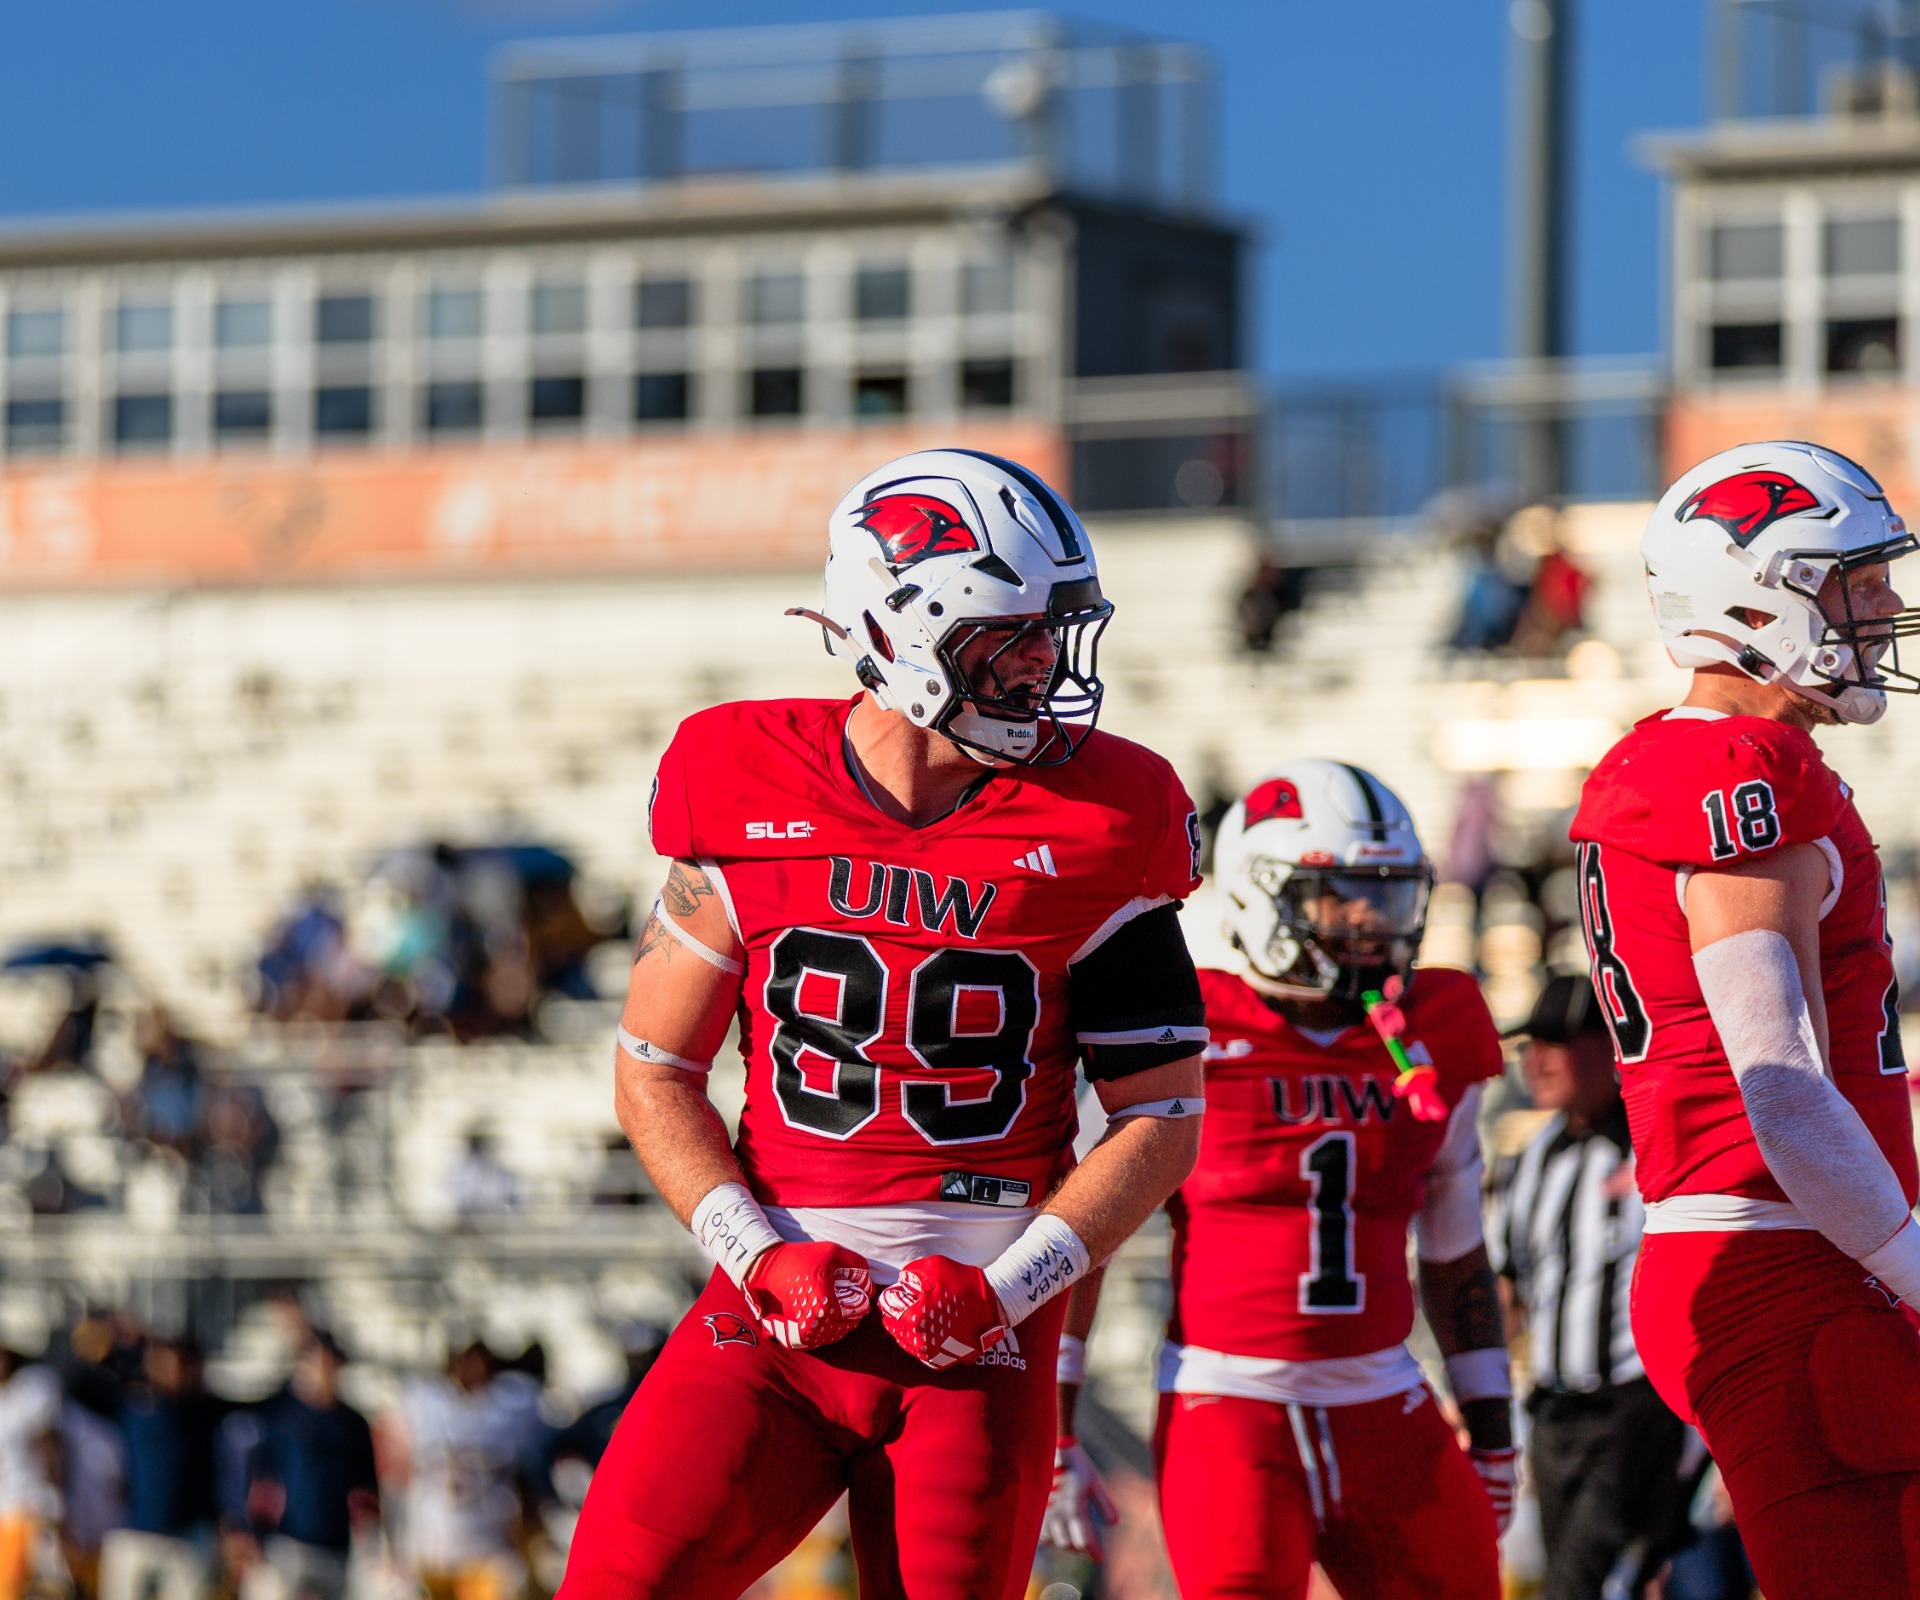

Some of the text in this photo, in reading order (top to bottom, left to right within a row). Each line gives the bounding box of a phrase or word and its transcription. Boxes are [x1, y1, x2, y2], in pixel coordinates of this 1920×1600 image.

[745, 820, 817, 840] SLC
[1702, 778, 1782, 861] 18
[828, 855, 997, 940] UIW
[763, 926, 1041, 1147] 89
[1266, 1073, 1397, 1126] UIW
[1297, 1130, 1366, 1315] 1
[1021, 1244, 1063, 1286] YAGA
[1028, 1255, 1074, 1302] BABA
[976, 1351, 1027, 1371] adidas
